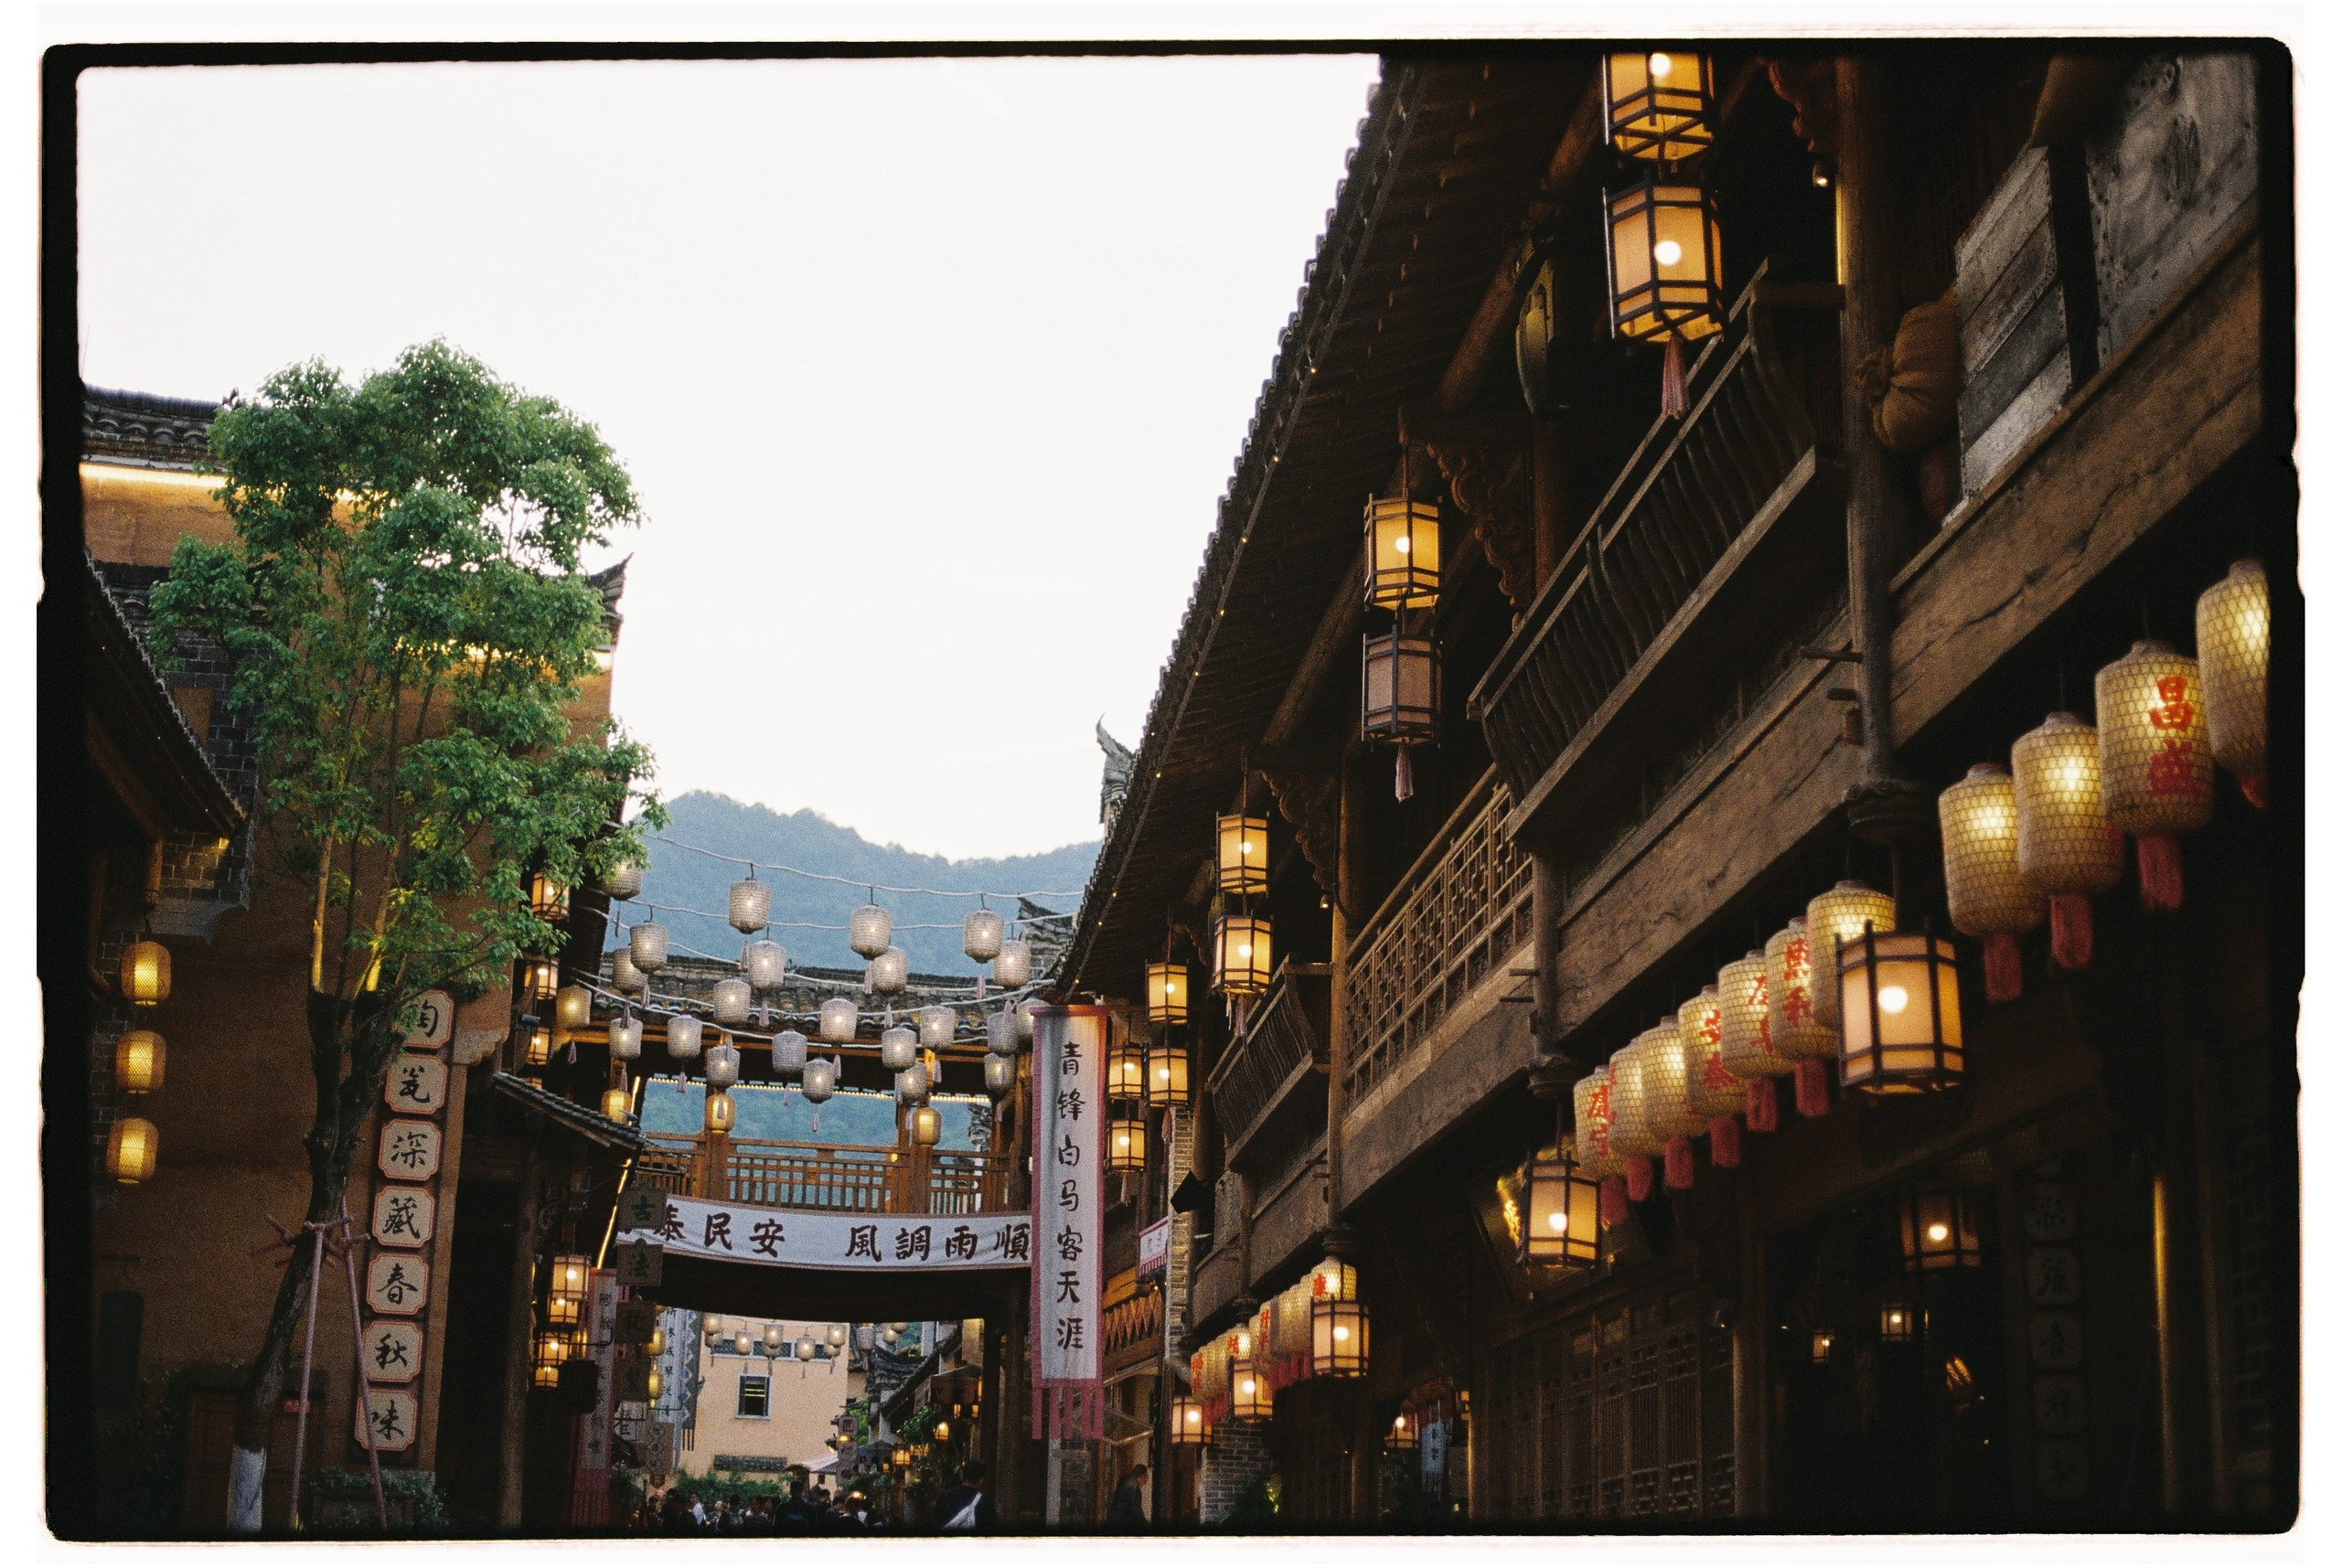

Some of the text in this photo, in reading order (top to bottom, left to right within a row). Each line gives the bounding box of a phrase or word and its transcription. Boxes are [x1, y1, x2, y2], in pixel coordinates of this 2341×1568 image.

[623, 1205, 1031, 1263] 泰民安 風調雨順
[1055, 1040, 1086, 1351] 青锋白马客天涯
